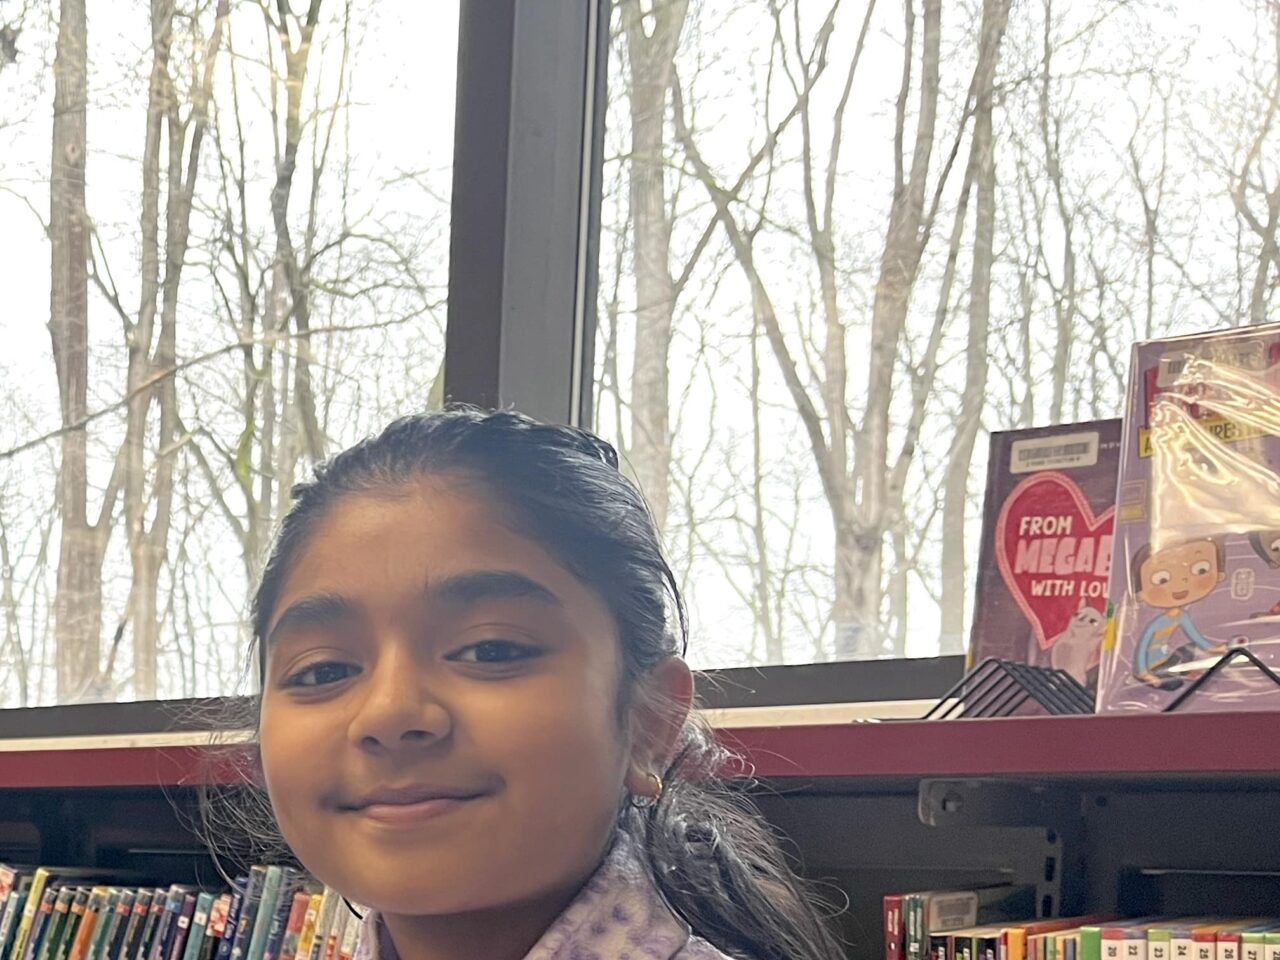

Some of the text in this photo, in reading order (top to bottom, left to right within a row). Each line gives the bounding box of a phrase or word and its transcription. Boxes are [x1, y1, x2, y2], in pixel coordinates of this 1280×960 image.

[1019, 516, 1072, 536] FROM
[1031, 579, 1075, 597] WITH
[1108, 946, 1117, 957] 20
[1128, 945, 1138, 956] 22
[1154, 948, 1164, 958] 23
[1178, 946, 1187, 956] 24
[1199, 948, 1209, 960] 25
[1224, 949, 1234, 960] 26
